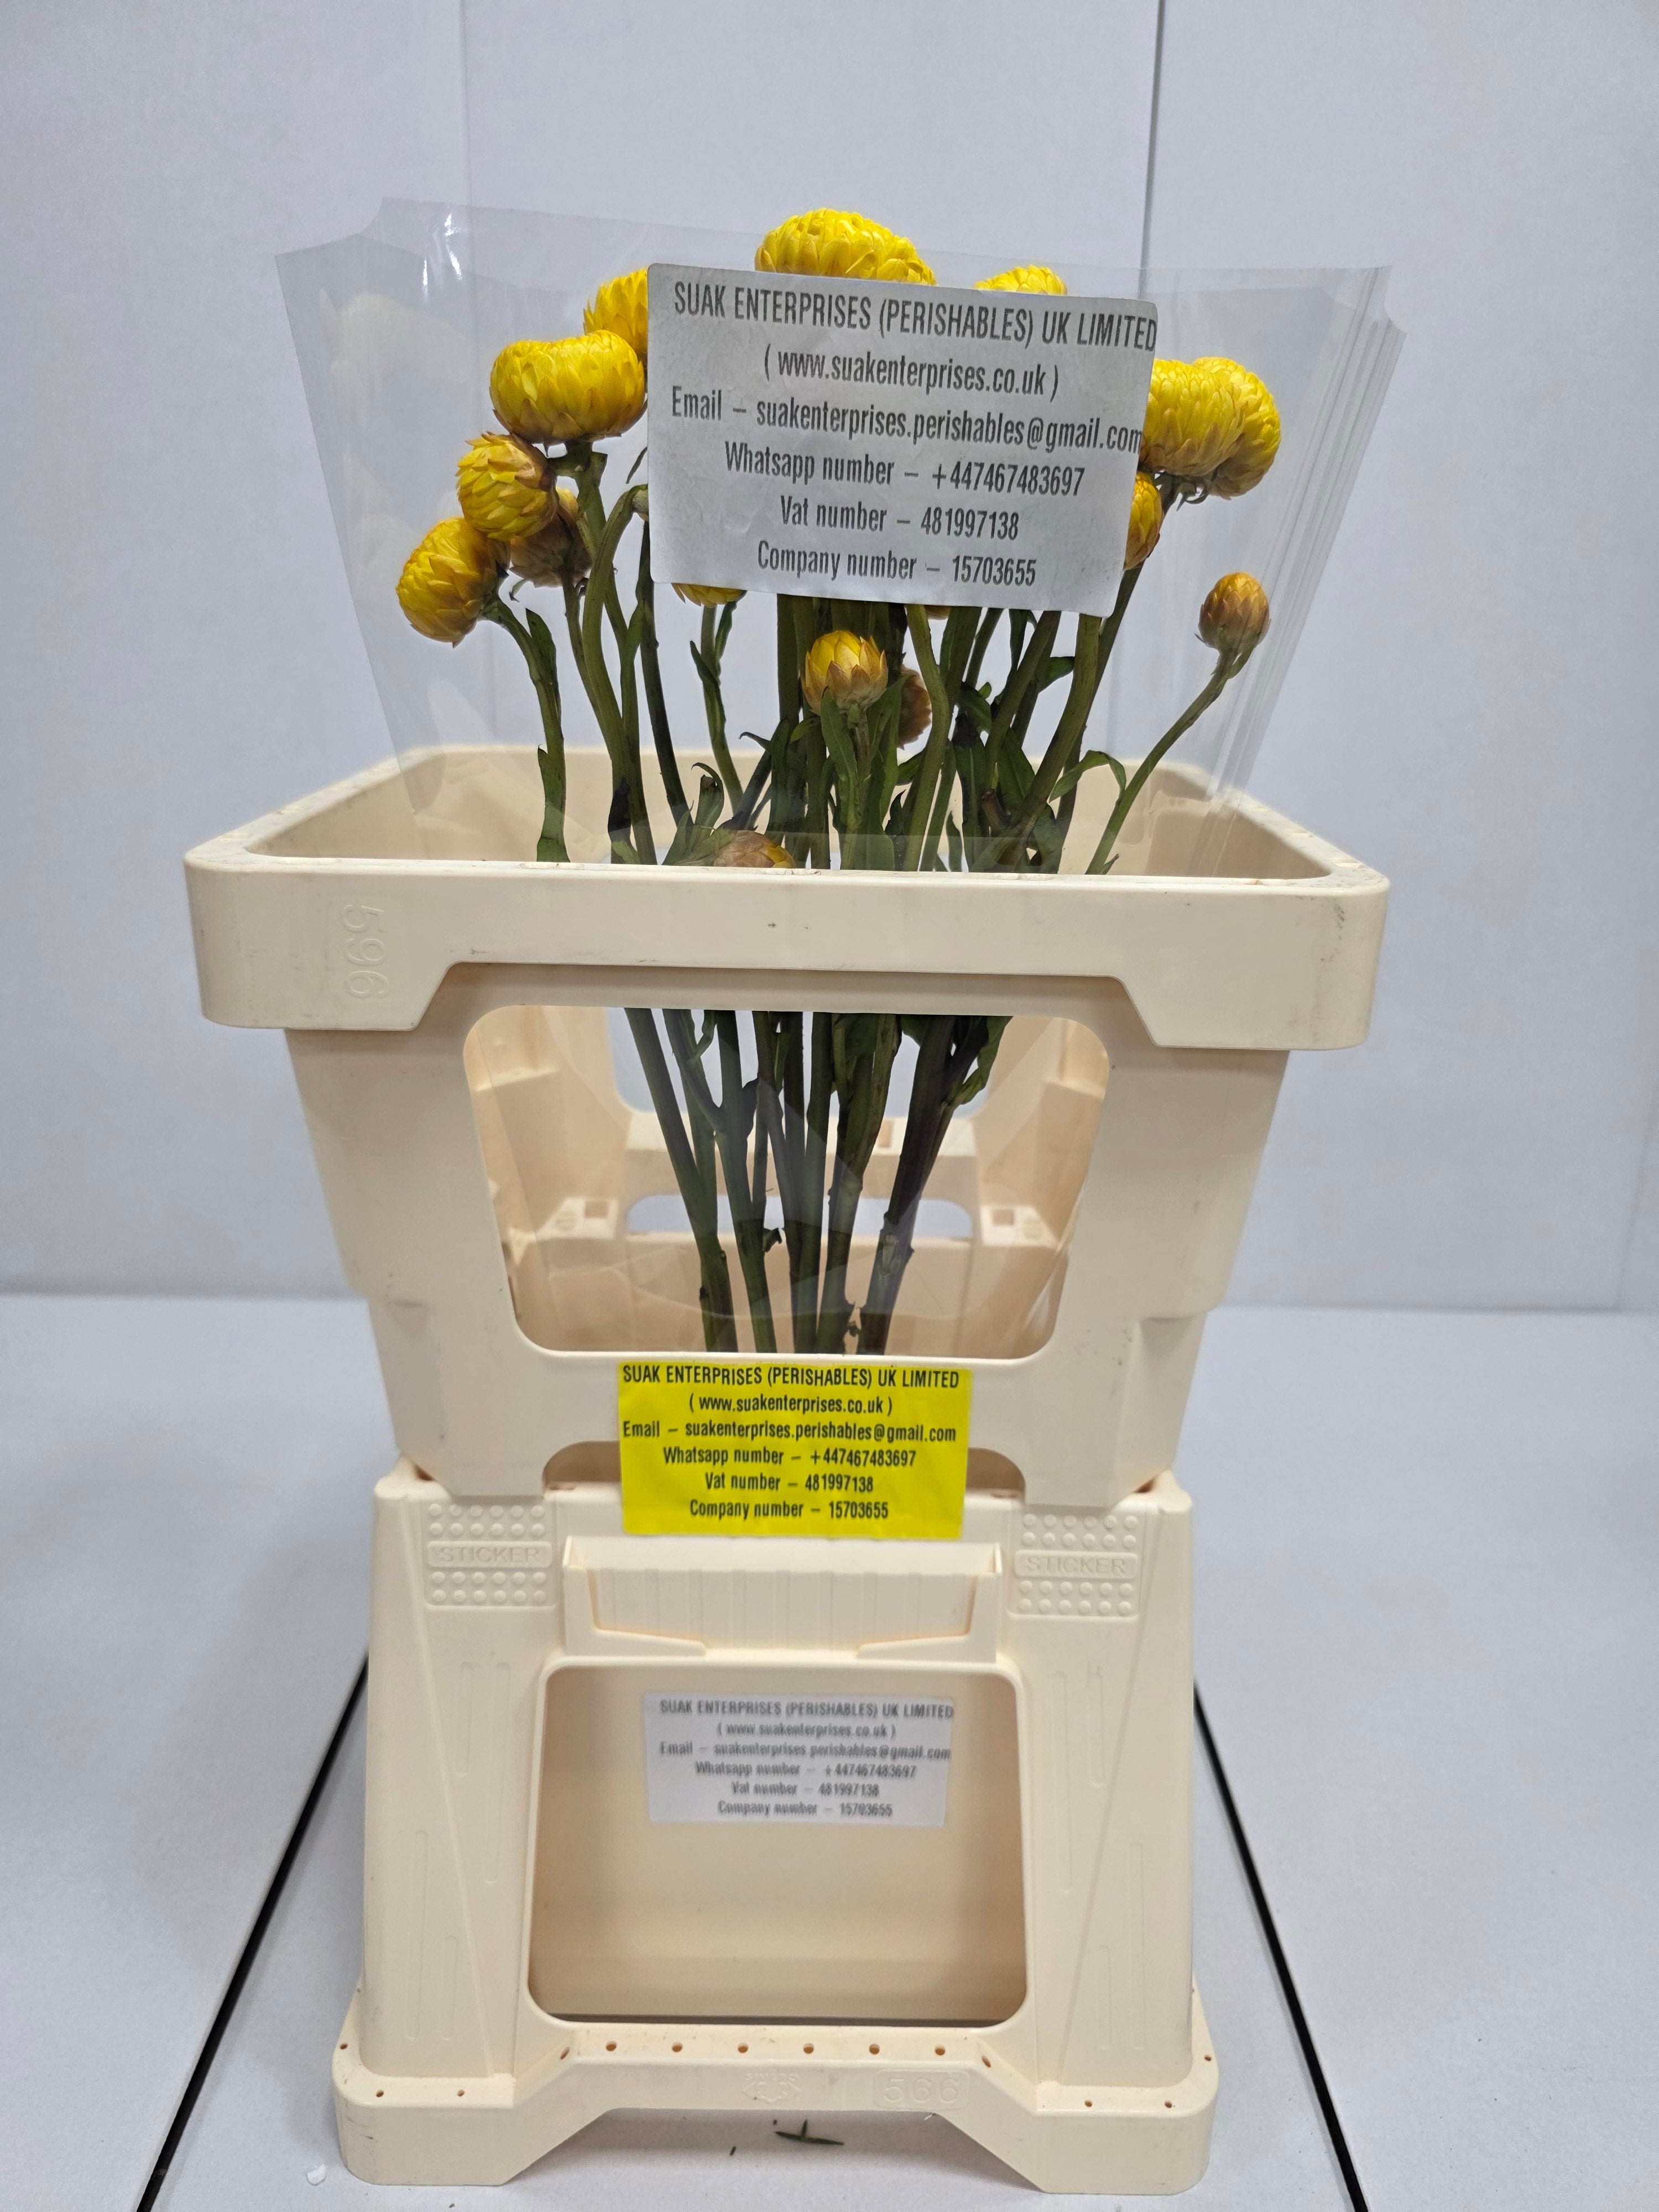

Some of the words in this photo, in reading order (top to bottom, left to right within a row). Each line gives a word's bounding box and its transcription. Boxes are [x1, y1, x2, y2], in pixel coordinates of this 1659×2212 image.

[675, 281, 726, 316] SUAK
[734, 288, 872, 329] ENTERPRISES
[879, 299, 1032, 347] (PERISHABLES)
[1042, 311, 1071, 345] UK
[1077, 314, 1157, 352] LIMITED
[764, 344, 771, 380] (
[778, 352, 1045, 395] www.suakenterprises.co.uk
[1050, 364, 1057, 402] )
[672, 386, 722, 420] Email
[757, 398, 1142, 453] suakenterprises.perishables@gmail.com
[725, 442, 815, 482] Whatsapp
[823, 455, 894, 484] number
[932, 461, 1084, 495] +447467483697
[781, 495, 808, 526] Vat
[816, 499, 887, 531] number
[921, 507, 1019, 540] 481997138
[758, 540, 840, 581] Company
[846, 549, 917, 578] number
[953, 555, 1037, 586] 15703655
[342, 904, 390, 999] 596
[623, 1366, 660, 1383] SUAK
[666, 1366, 762, 1384] ENTERPRISES
[768, 1368, 872, 1390] (PERISHABLES)
[878, 1370, 896, 1387] UK
[902, 1370, 959, 1387] LIMITED
[690, 1394, 695, 1412] (
[699, 1394, 883, 1415] www.suakenterprises.co.uk
[887, 1397, 892, 1415] )
[623, 1421, 660, 1437] Email
[685, 1420, 956, 1442] suakenterprises.perishables@gmail.com
[664, 1447, 728, 1465] Whatsapp
[734, 1448, 784, 1464] number
[810, 1448, 916, 1467] +447467483697
[705, 1473, 726, 1490] Vat
[731, 1474, 780, 1491] number
[805, 1474, 874, 1492] 481997138
[690, 1499, 749, 1520] Company
[754, 1501, 804, 1517] number
[830, 1501, 888, 1519] 15703655
[439, 1547, 540, 1563] STICKER
[1027, 1556, 1125, 1574] STICKER
[885, 2078, 961, 2103] 566
